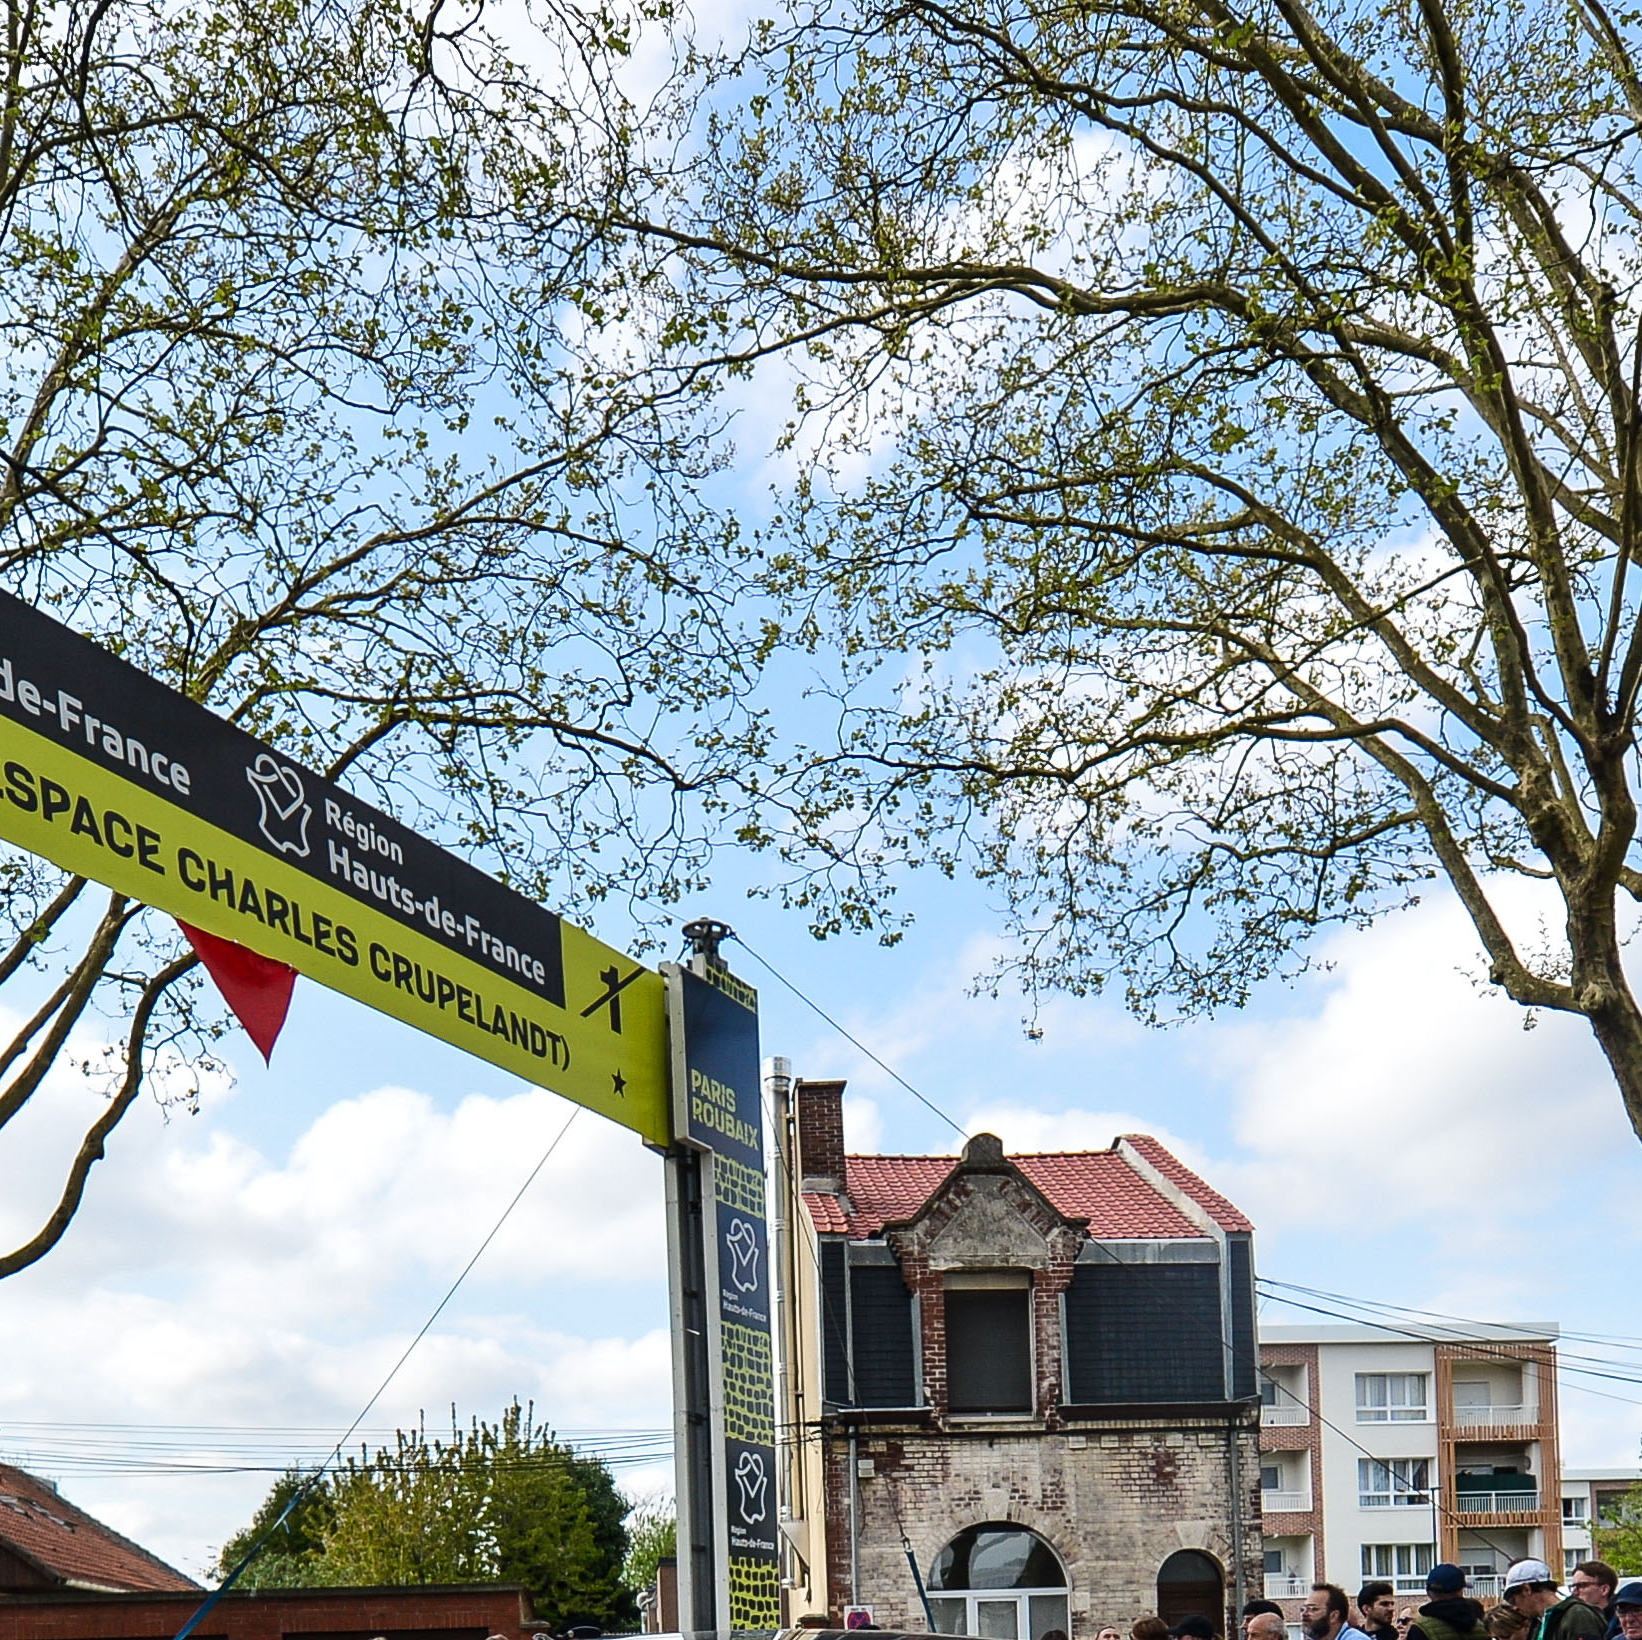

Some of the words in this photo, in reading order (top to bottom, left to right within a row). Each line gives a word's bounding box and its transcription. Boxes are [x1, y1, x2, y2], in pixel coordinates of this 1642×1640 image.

[325, 797, 403, 866] Région
[328, 838, 545, 986] Hauts-de-France
[176, 847, 359, 968] CHARLES
[370, 941, 570, 1072] CRUPELANDT)
[690, 1068, 736, 1114] PARIS
[692, 1096, 759, 1150] ROUBAIX
